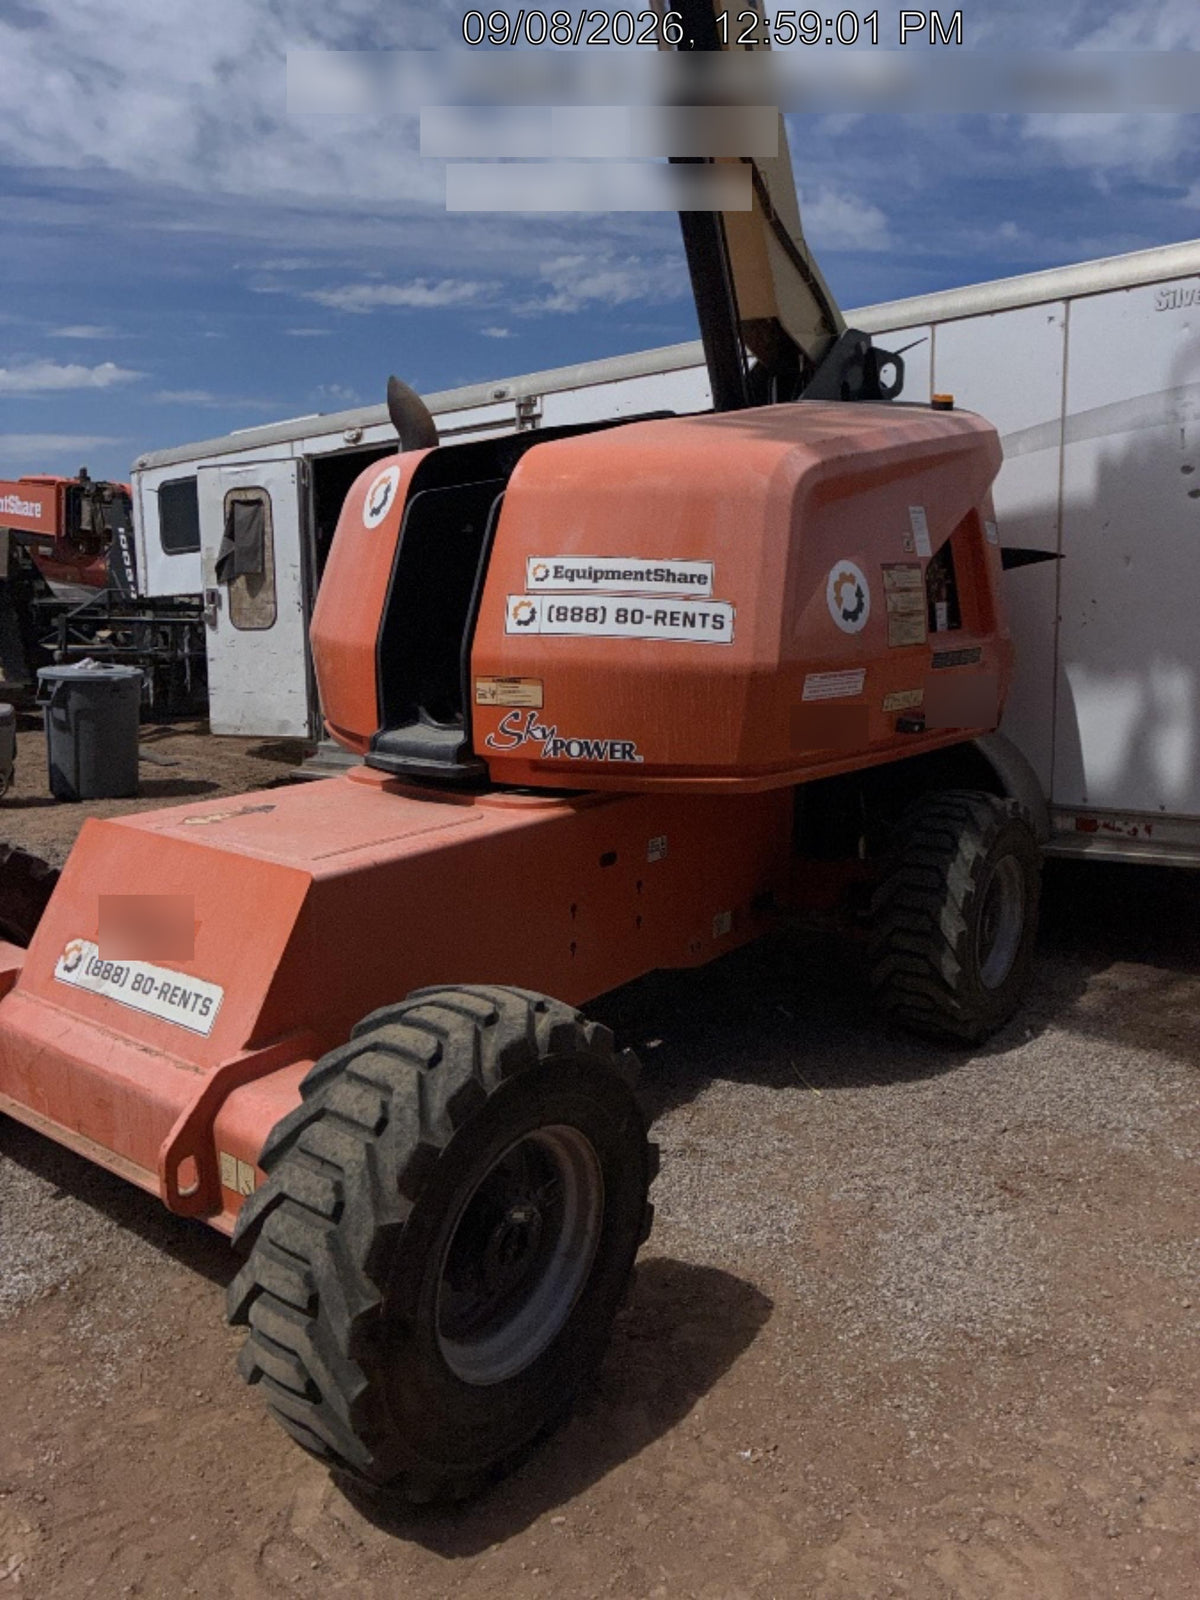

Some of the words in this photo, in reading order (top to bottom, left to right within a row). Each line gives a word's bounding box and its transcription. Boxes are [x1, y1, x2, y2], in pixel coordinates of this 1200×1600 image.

[552, 564, 709, 586] EquipmentShare
[547, 604, 607, 625] (888)
[615, 607, 726, 630] 80-RENTS
[85, 955, 130, 987] (888)
[130, 973, 213, 1016] 80-RENTS
